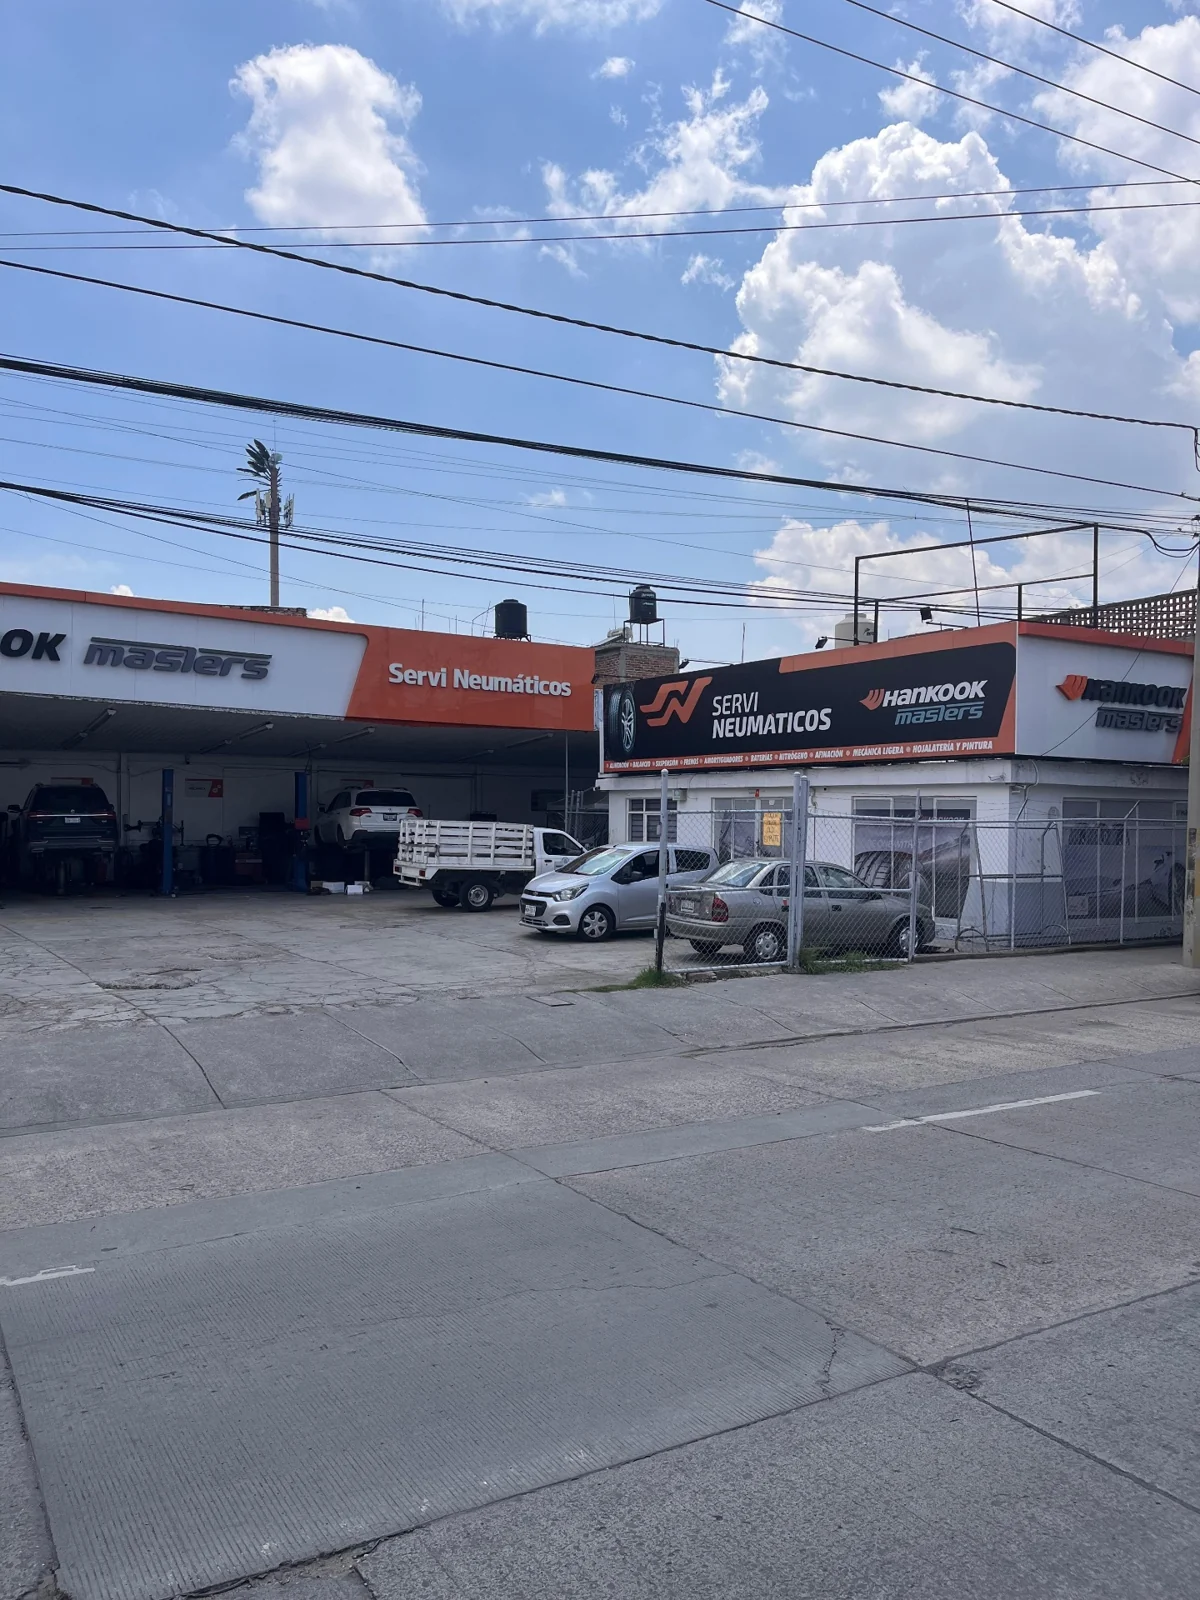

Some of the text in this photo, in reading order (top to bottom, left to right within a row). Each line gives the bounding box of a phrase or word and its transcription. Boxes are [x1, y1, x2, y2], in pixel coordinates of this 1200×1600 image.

[388, 662, 572, 697] Servi Neumáticos
[712, 691, 759, 716] SERVI
[750, 753, 773, 762] BATERÍAS
[778, 749, 808, 761] NITRÓGENO
[815, 749, 843, 759] AFINACIÓN
[852, 746, 881, 757] MECÁNICA
[882, 746, 904, 755] LIGERA
[912, 741, 954, 753] HOJALATERÍA
[956, 742, 960, 751] Y
[961, 740, 993, 750] PINTURA
